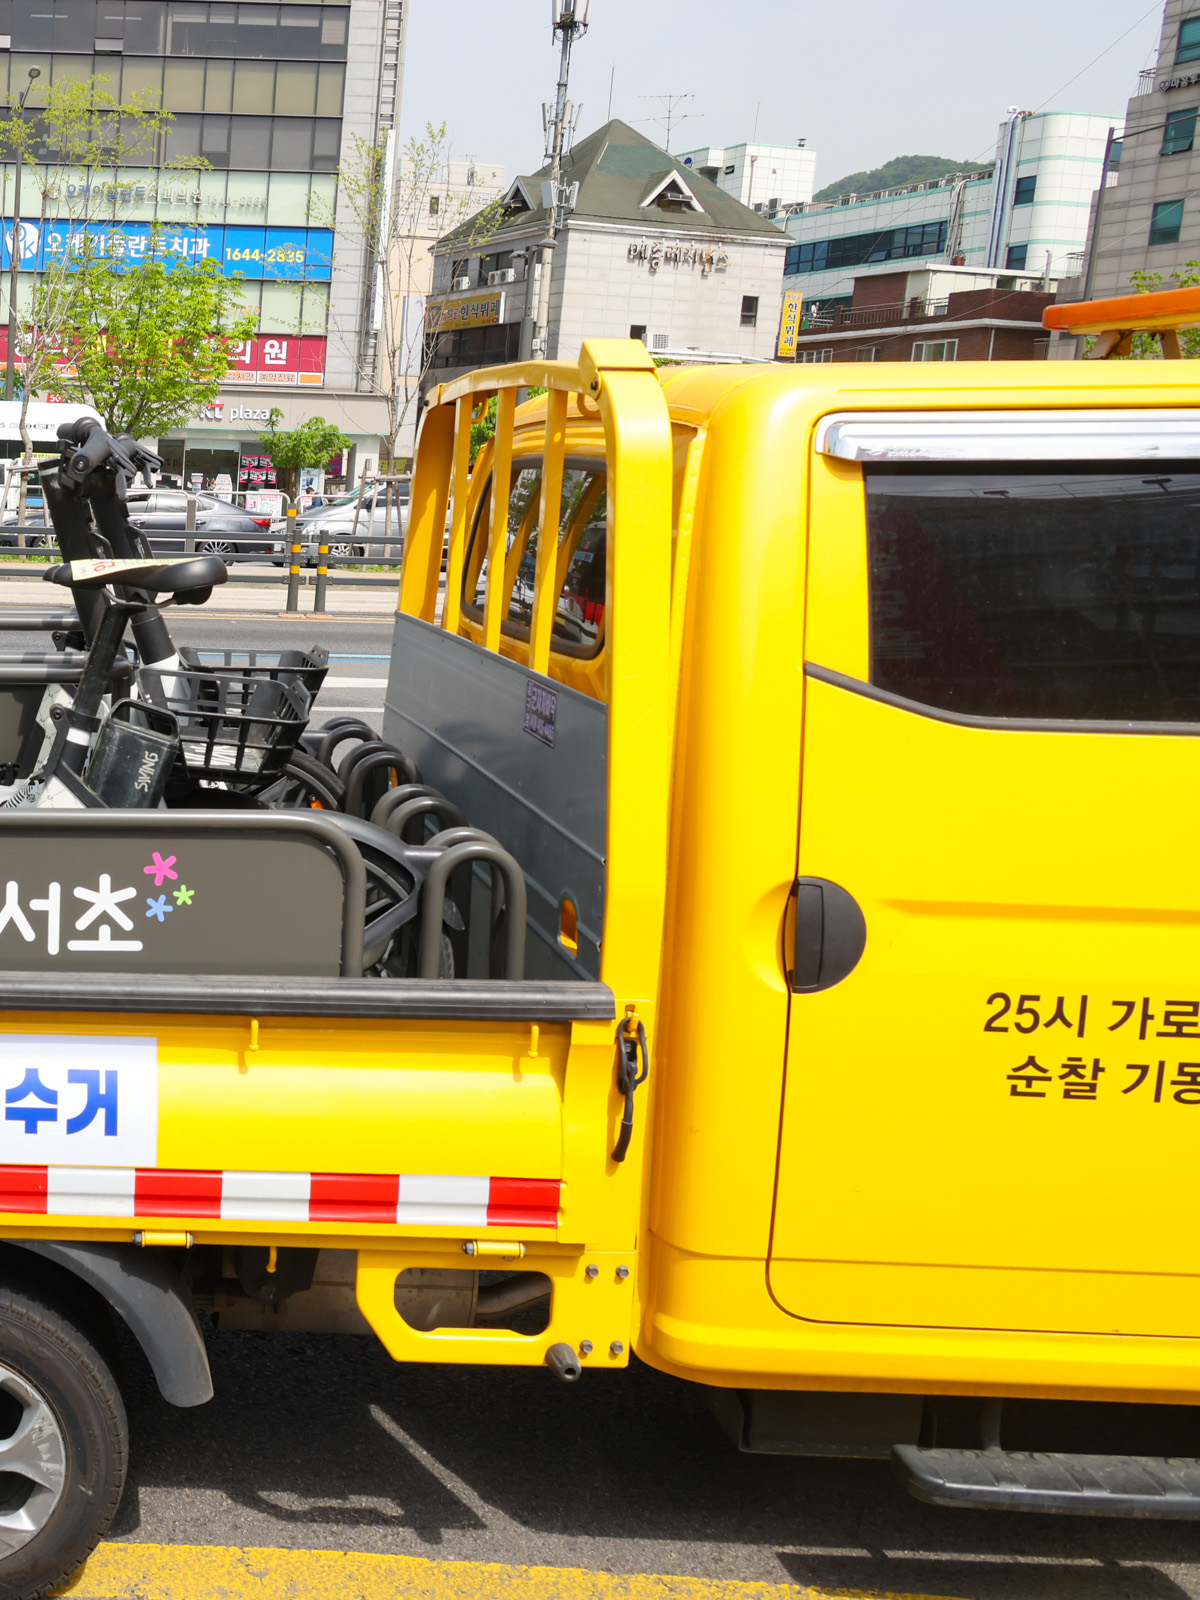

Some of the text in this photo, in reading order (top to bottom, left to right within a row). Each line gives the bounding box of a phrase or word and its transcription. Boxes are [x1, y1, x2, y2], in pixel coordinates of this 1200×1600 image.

[461, 299, 500, 321] 한식뷔페
[783, 303, 799, 347] 한식뷔페
[229, 405, 271, 421] plaza
[983, 991, 1200, 1040] 25시 가로
[1006, 1055, 1200, 1105] 순찰 기동
